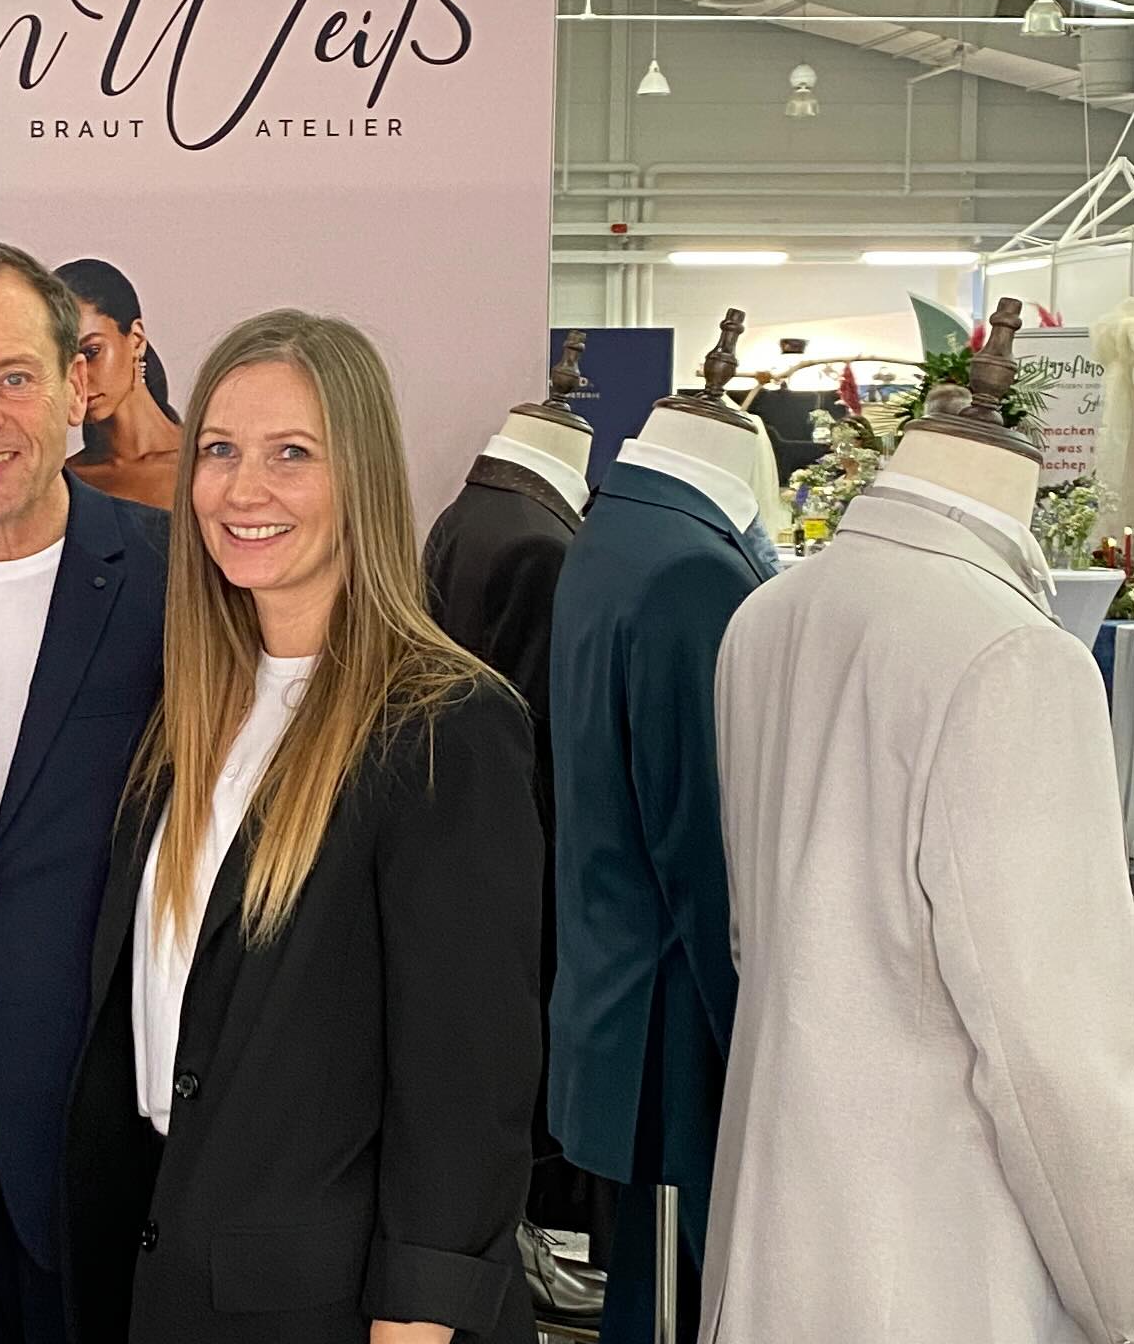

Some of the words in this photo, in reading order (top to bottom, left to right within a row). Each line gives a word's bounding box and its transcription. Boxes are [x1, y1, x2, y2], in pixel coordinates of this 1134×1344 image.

[30, 120, 145, 140] BRAUT
[254, 119, 404, 140] ATELIER
[1057, 444, 1083, 454] was
